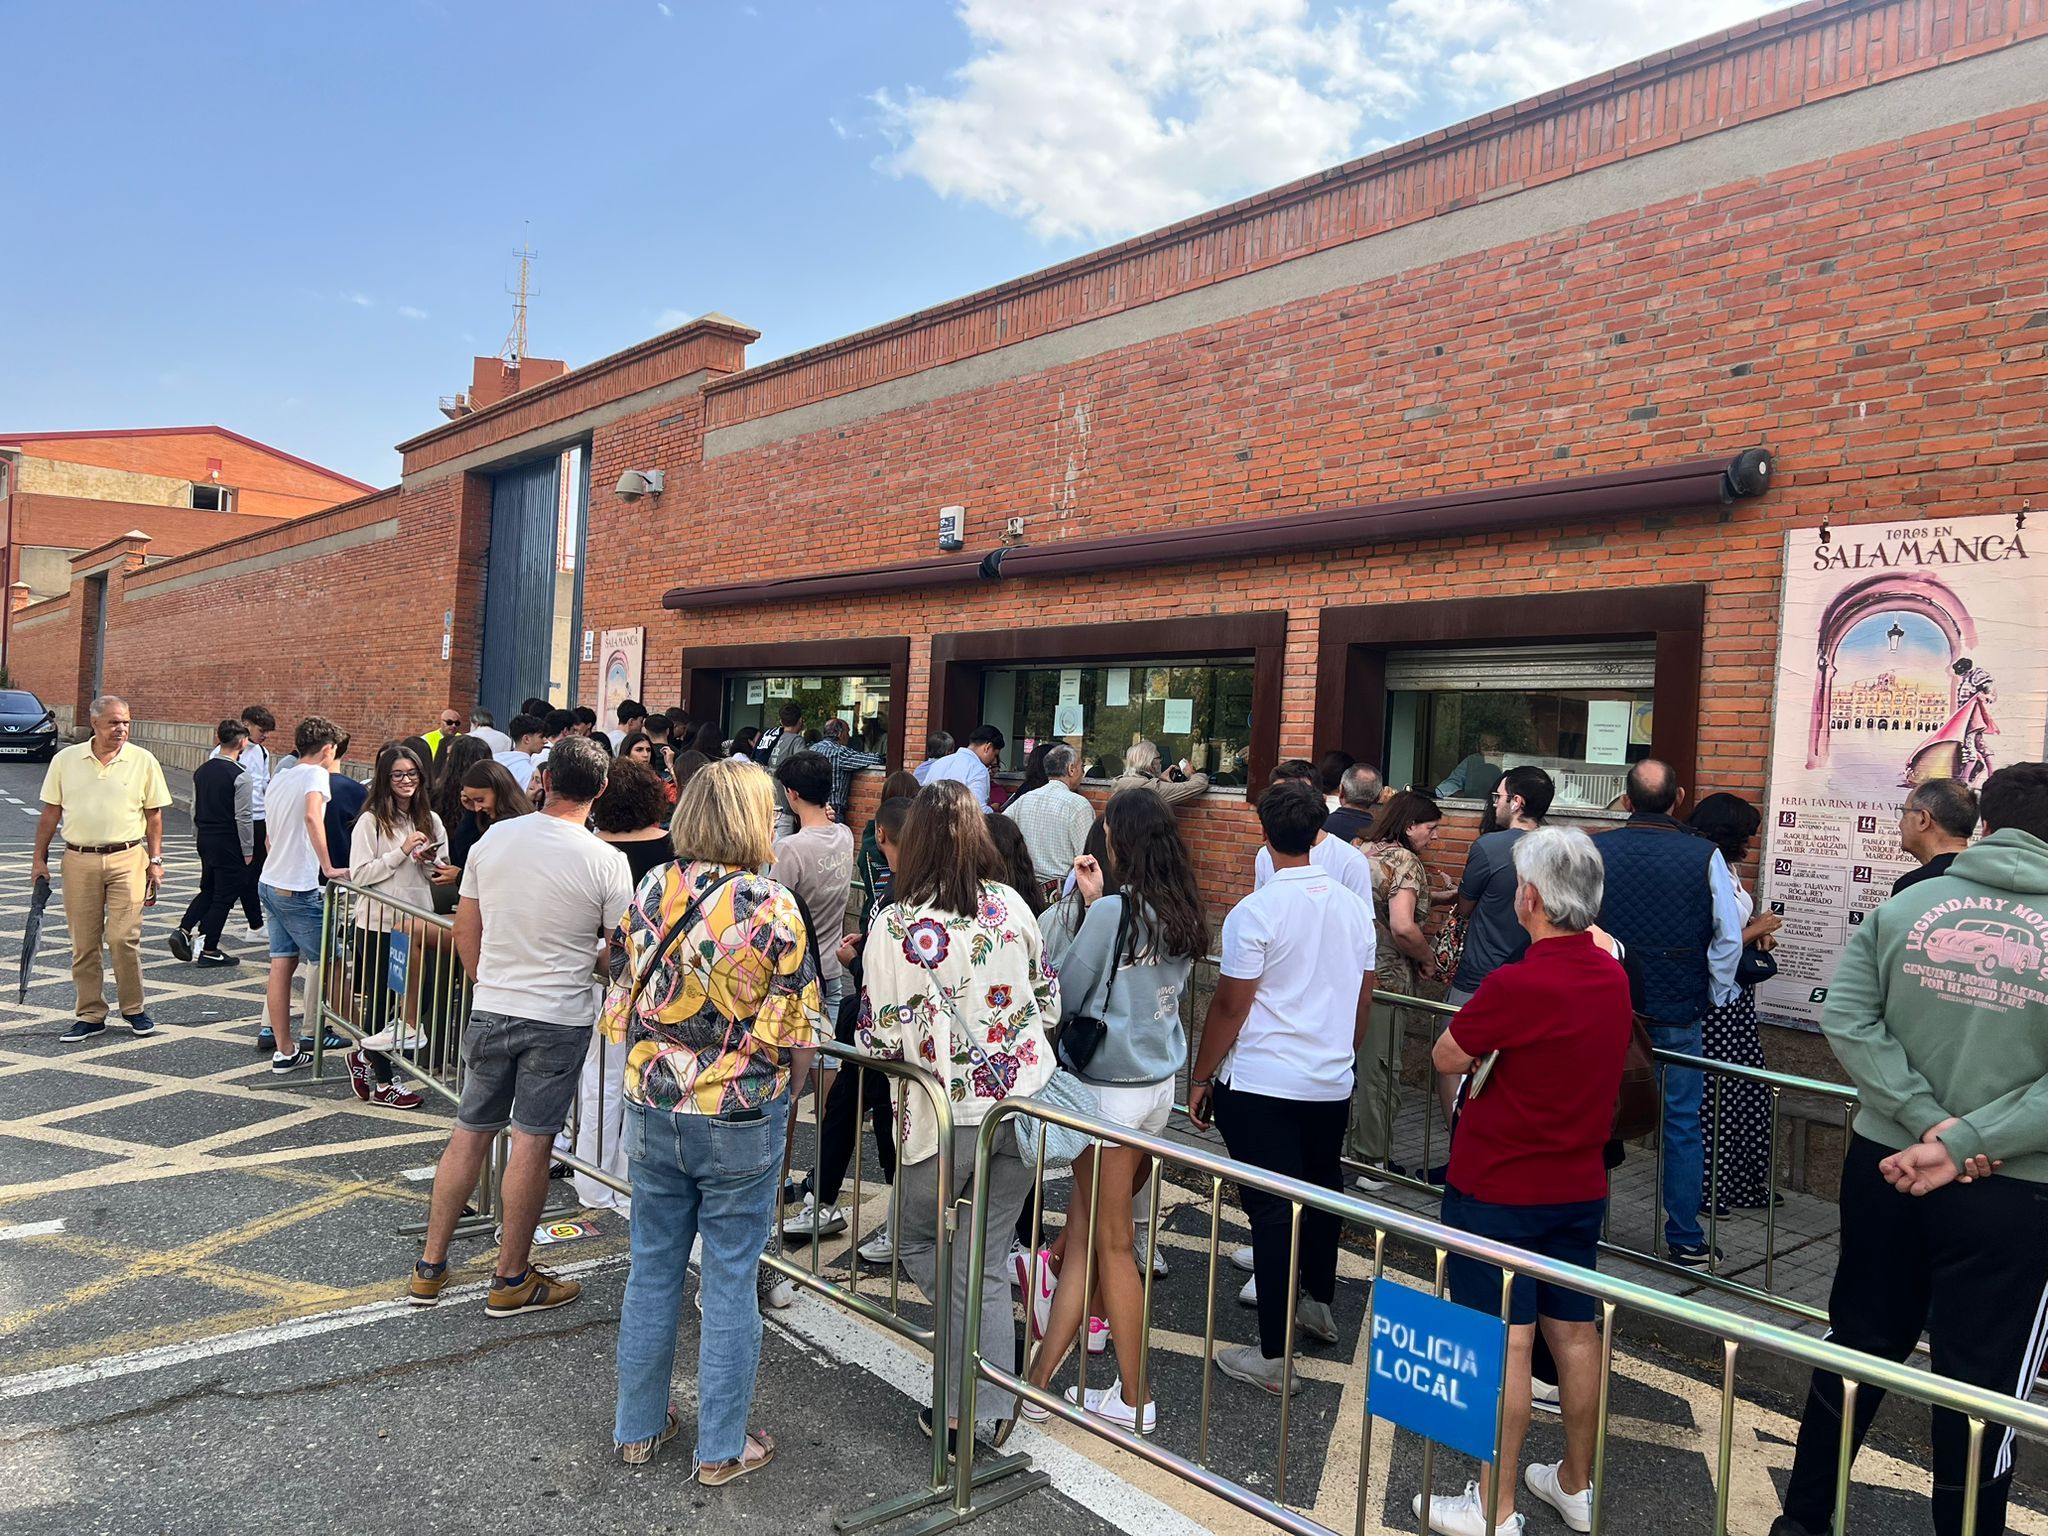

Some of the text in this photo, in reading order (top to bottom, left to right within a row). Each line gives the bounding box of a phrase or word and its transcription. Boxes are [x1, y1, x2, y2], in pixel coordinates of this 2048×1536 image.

[1886, 525, 1953, 541] TOROS EN
[1813, 533, 2030, 571] SALAMANCA
[605, 635, 638, 648] SALAMANCA
[1781, 797, 1808, 806] FERIA
[1811, 798, 1853, 809] TAVRINA
[1857, 801, 1869, 810] DE
[1872, 802, 1883, 811] LA
[1782, 812, 1795, 824] 13
[1861, 817, 1874, 829] 14
[1783, 832, 1840, 842] RAQUEL MARTÍN
[1861, 838, 1886, 846] PABLO
[1794, 839, 1804, 847] DE
[1816, 841, 1848, 850] CALZADA
[1862, 844, 1895, 854] ENRIQUE
[1782, 845, 1839, 857] JAVIER ZULUETA
[1865, 852, 1892, 861] MARCO
[1775, 860, 1791, 871] 20
[835, 866, 847, 880] CO
[1855, 867, 1869, 879] 21
[1788, 887, 1824, 897] ROCA REY
[1804, 882, 1843, 893] TALAVANTE
[1862, 888, 1888, 897] SERGIO
[1779, 893, 1833, 905] PABLO AGUADO
[1857, 894, 1881, 903] DIEGO
[1852, 912, 1860, 922] 8
[1906, 896, 2009, 951] LEGENDARY
[1902, 962, 1957, 982] GENUINE
[1959, 972, 1998, 990] MOTOR
[1919, 976, 1944, 991] FOR
[1999, 992, 2026, 1010] LIFE
[1372, 1314, 1479, 1379] POLICIA
[1374, 1348, 1468, 1409] LOCAL
